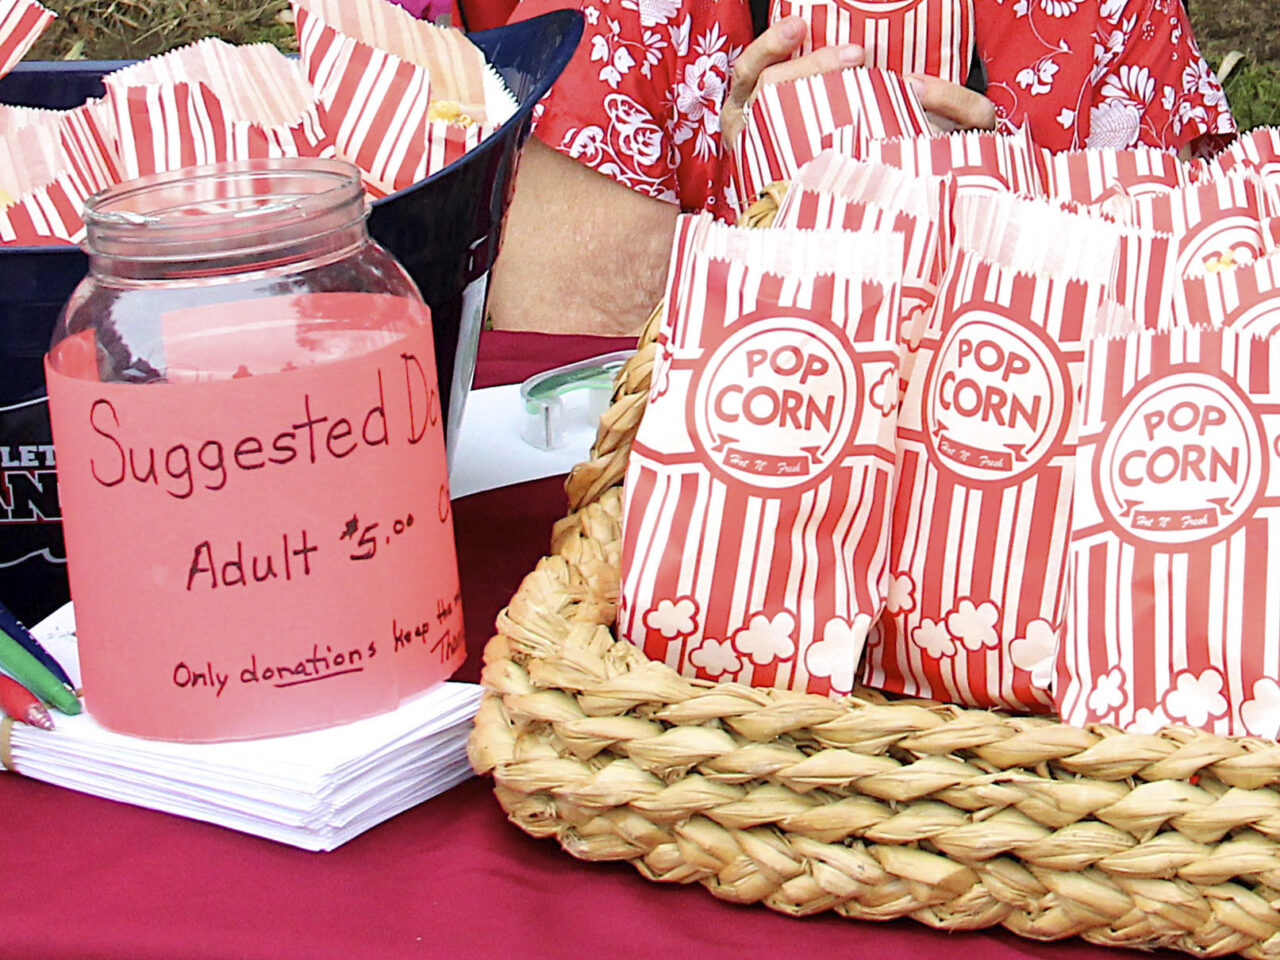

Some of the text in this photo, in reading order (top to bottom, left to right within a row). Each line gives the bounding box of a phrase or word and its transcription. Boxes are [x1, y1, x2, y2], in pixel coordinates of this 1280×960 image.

[746, 345, 829, 385] POP
[959, 339, 1030, 382] POP
[714, 384, 835, 433] CORN
[939, 371, 1041, 433] CORN
[1143, 401, 1227, 442] POP
[90, 368, 388, 499] Suggested
[1118, 444, 1239, 487] CORN
[187, 530, 318, 591] Adult
[173, 654, 229, 698] Only
[240, 641, 377, 685] donations
